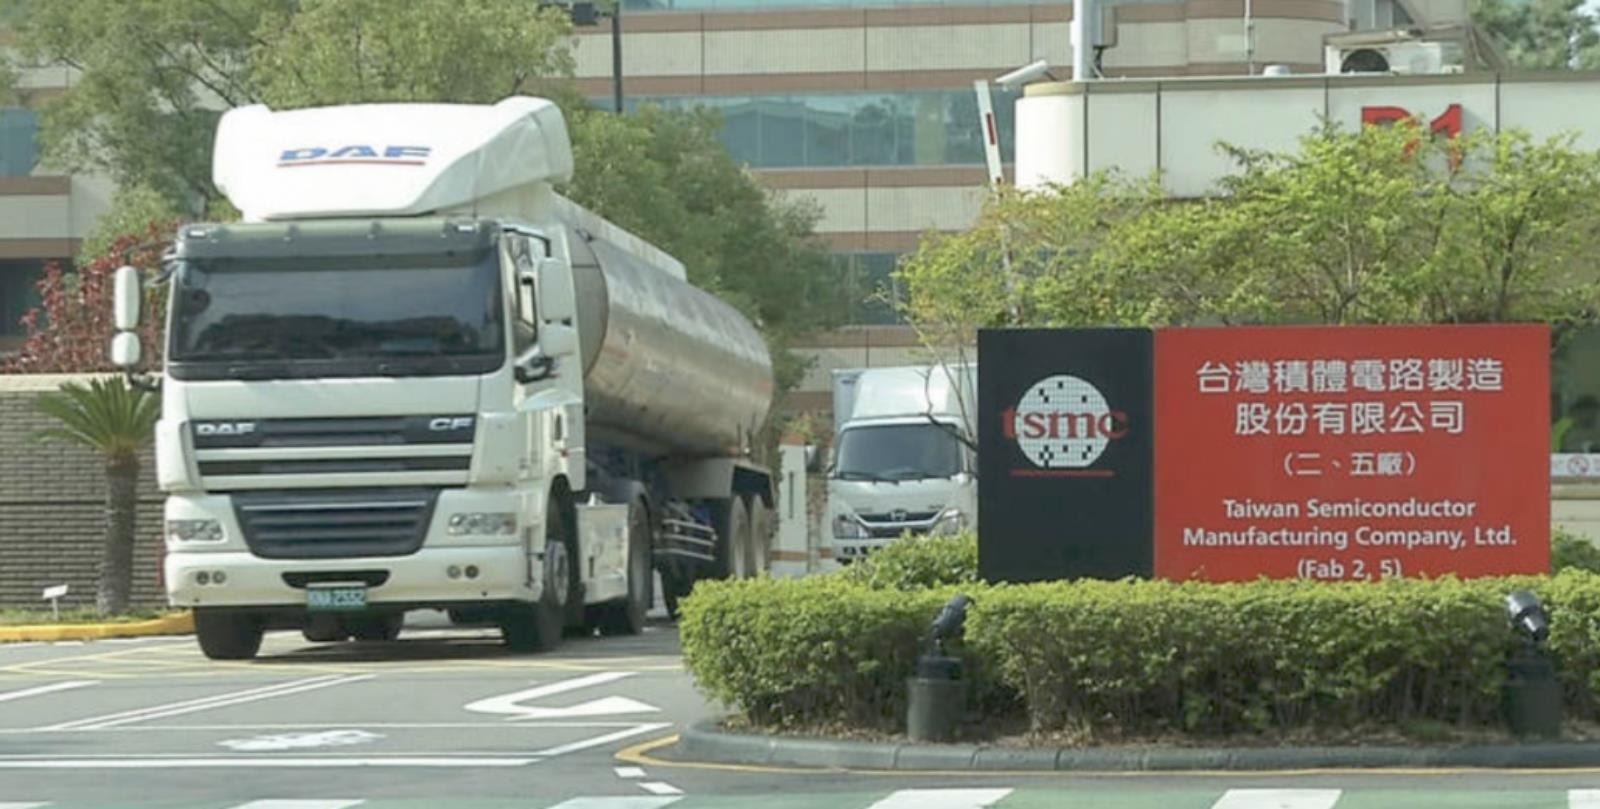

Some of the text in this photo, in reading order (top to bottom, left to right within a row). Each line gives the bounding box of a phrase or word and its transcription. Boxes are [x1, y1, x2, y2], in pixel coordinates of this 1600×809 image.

[280, 145, 431, 161] DAF
[1196, 358, 1504, 393] 台灣積體電路製造
[429, 417, 473, 431] CF
[1001, 406, 1129, 440] tsmc
[1235, 401, 1465, 435] 股份有限公司
[196, 422, 257, 436] DAF
[1223, 498, 1476, 518] Taiwan Semiconductor
[1183, 525, 1517, 550] Manufacturing Company, Ltd.
[1298, 558, 1345, 579] (Fab
[1380, 558, 1402, 578] 5)
